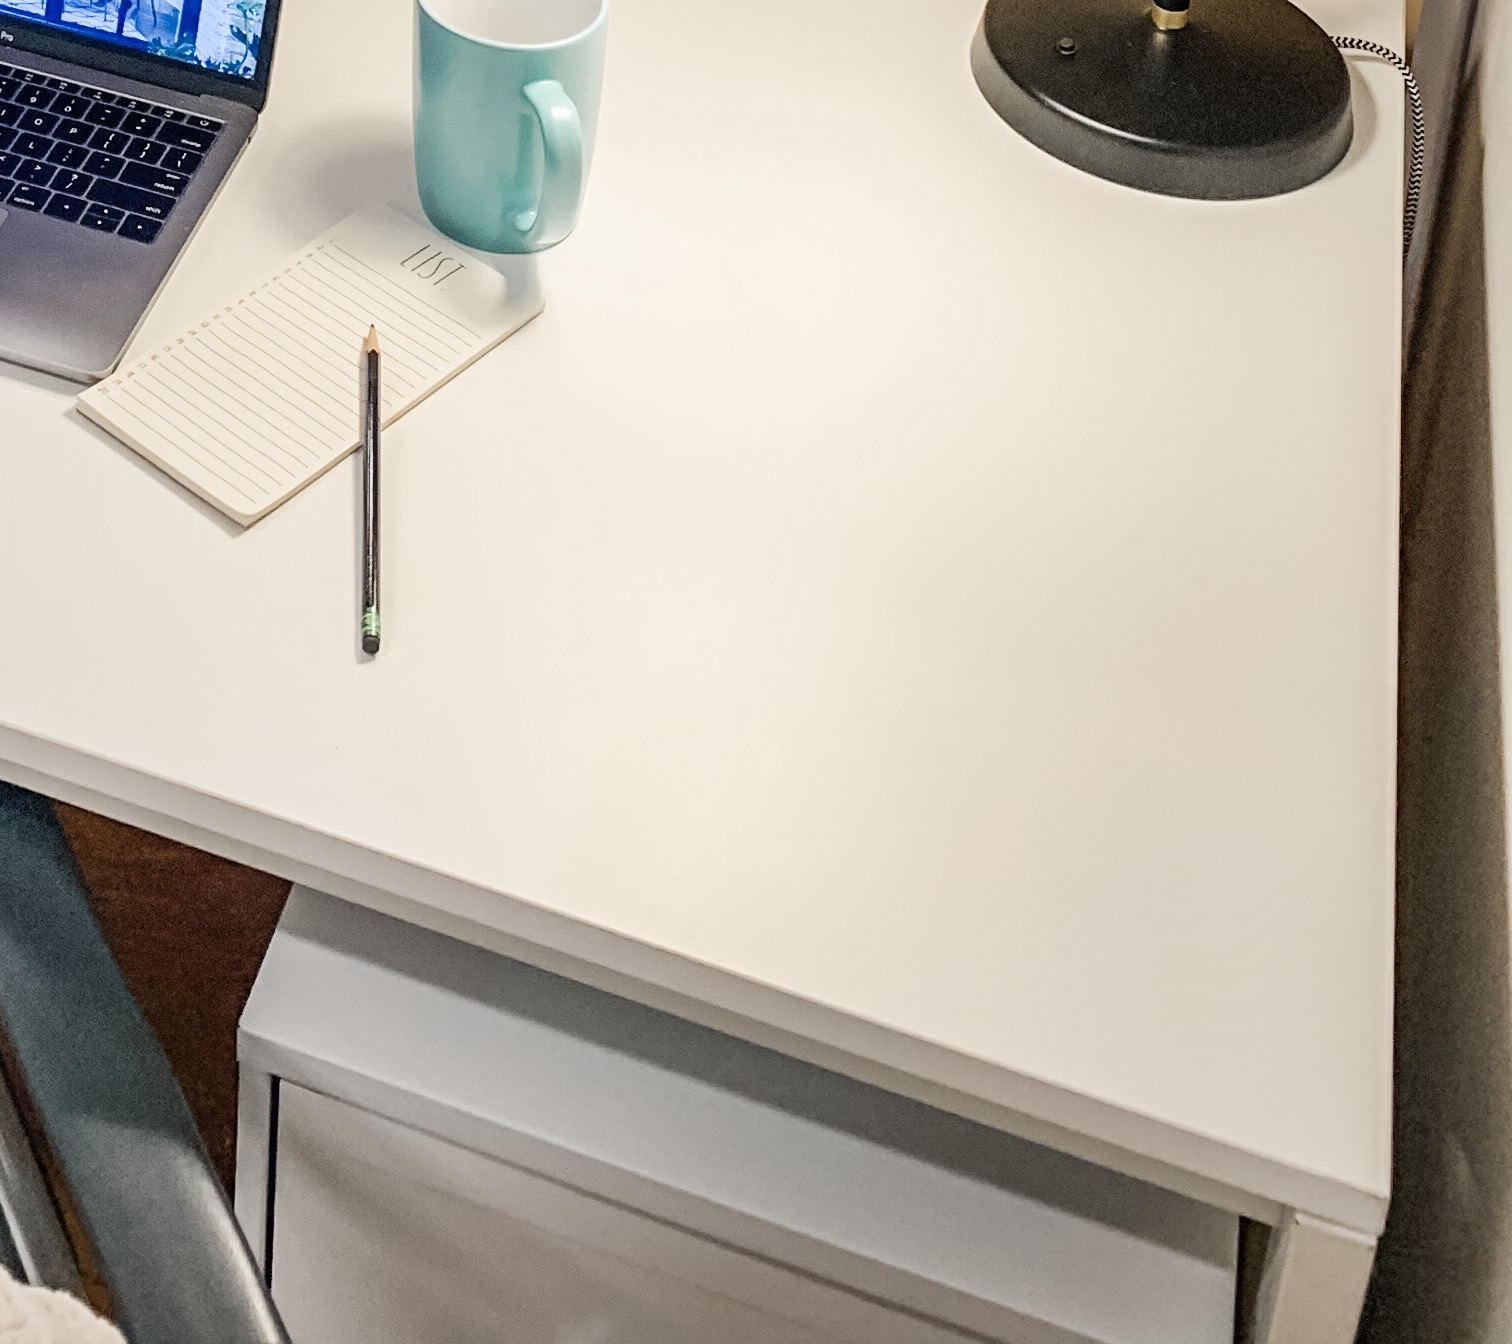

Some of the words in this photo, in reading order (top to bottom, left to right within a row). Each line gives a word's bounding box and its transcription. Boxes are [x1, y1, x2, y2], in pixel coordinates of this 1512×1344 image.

[0, 30, 14, 42] Pro
[34, 118, 43, 126] O
[28, 141, 35, 150] L
[400, 244, 467, 286] LIST
